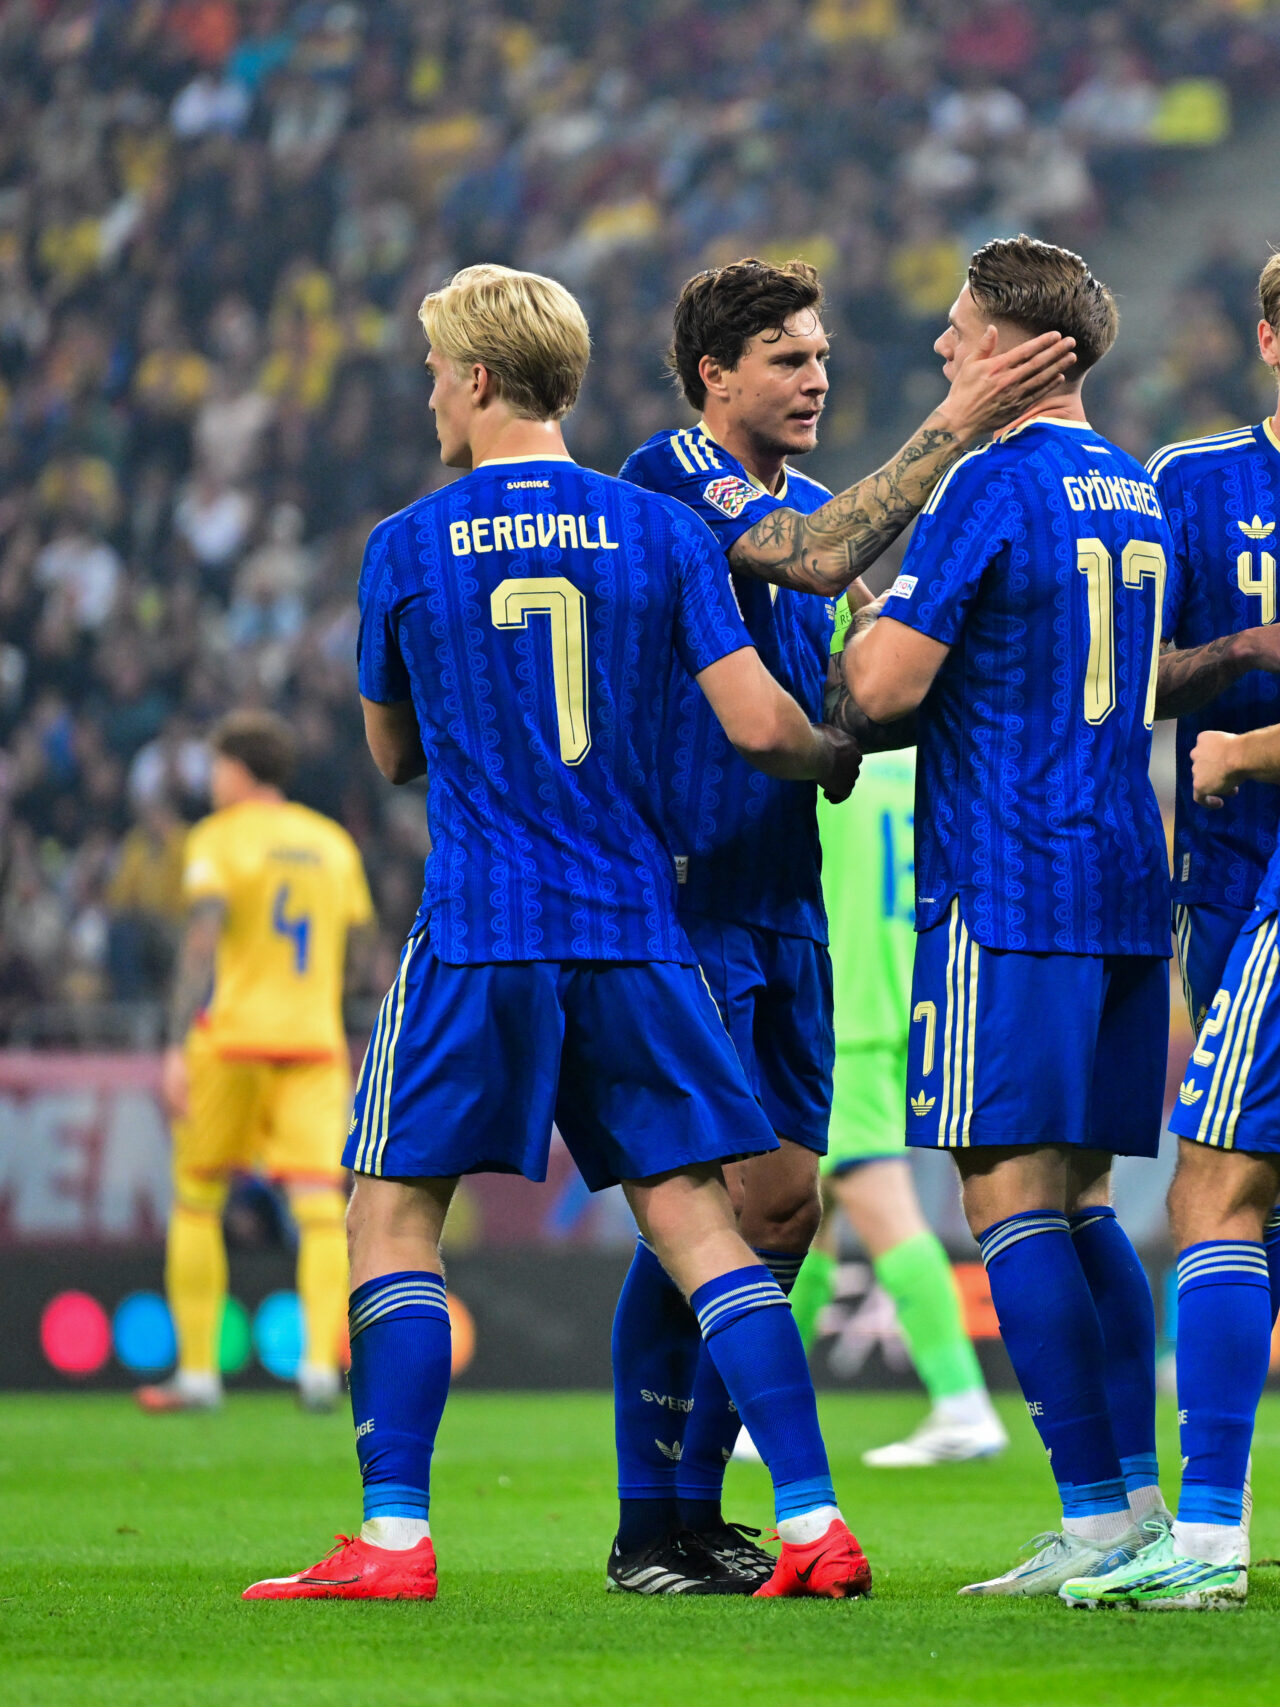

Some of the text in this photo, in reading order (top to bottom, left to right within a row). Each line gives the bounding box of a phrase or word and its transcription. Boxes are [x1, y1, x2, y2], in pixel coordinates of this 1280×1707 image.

[506, 480, 550, 490] SVERIGE
[1062, 469, 1162, 520] GYÖKERES
[449, 513, 619, 557] BERGVALL
[1237, 551, 1276, 626] 4
[490, 576, 592, 766] 7
[1076, 537, 1168, 731] 17
[272, 880, 310, 976] 4
